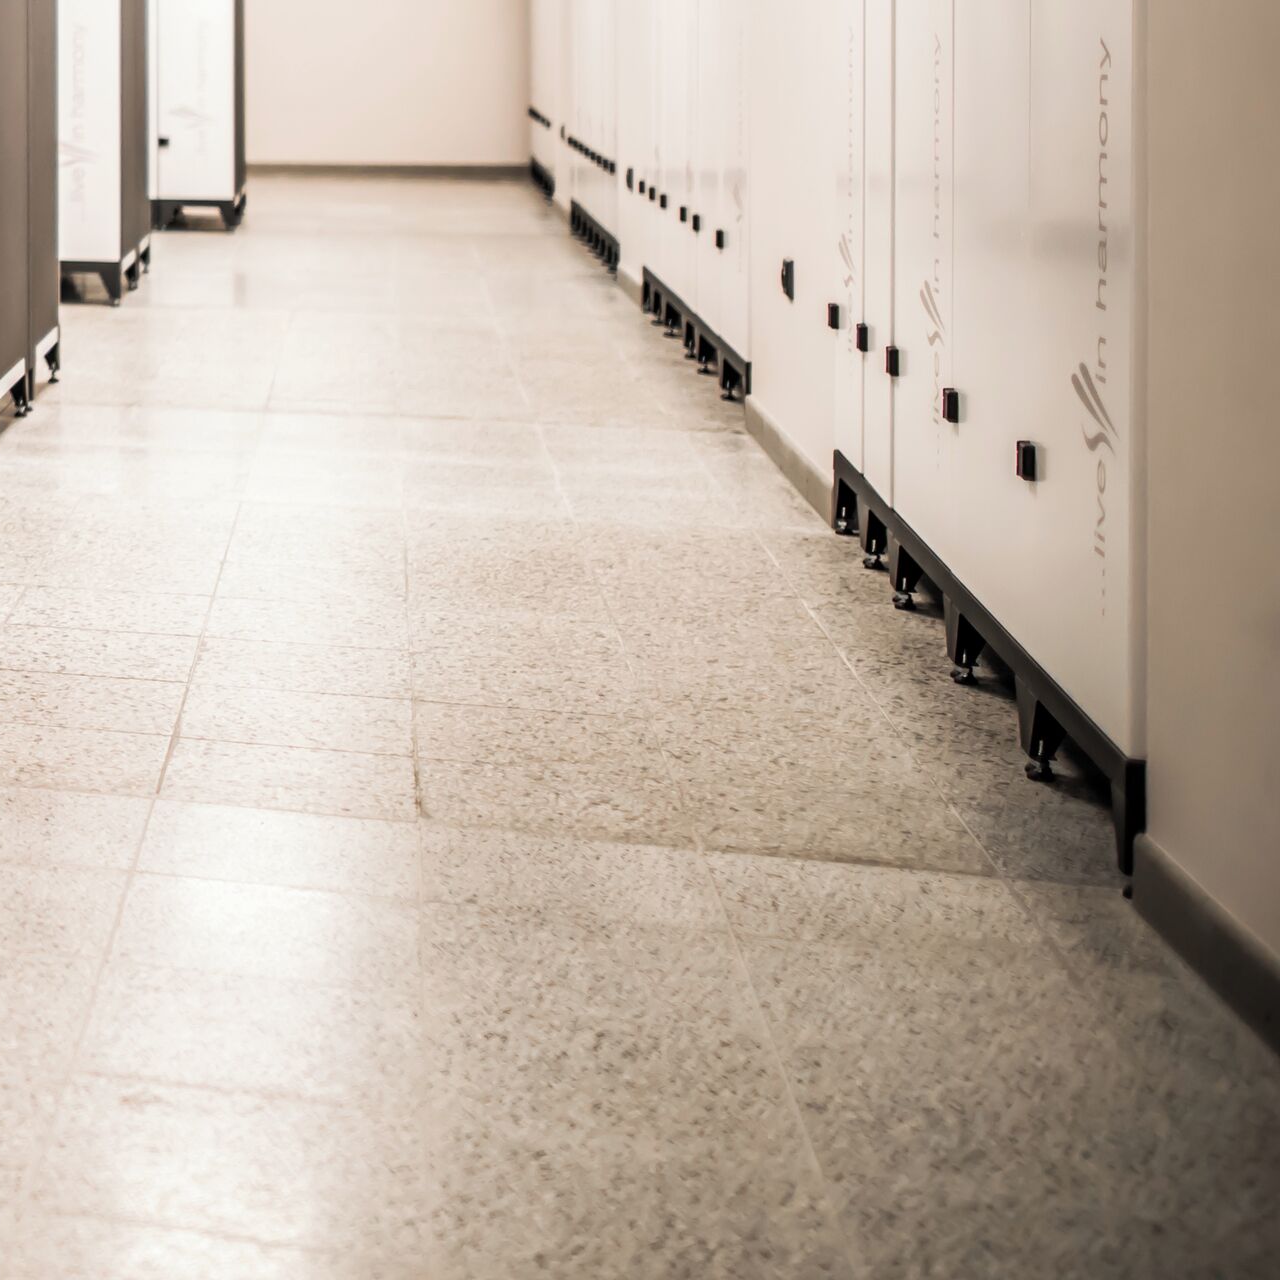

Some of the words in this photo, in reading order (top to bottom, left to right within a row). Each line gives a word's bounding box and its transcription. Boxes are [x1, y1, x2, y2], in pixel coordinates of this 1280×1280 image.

[1095, 37, 1111, 311] harmony
[1095, 335, 1107, 384] in
[1094, 459, 1107, 616] ...live
